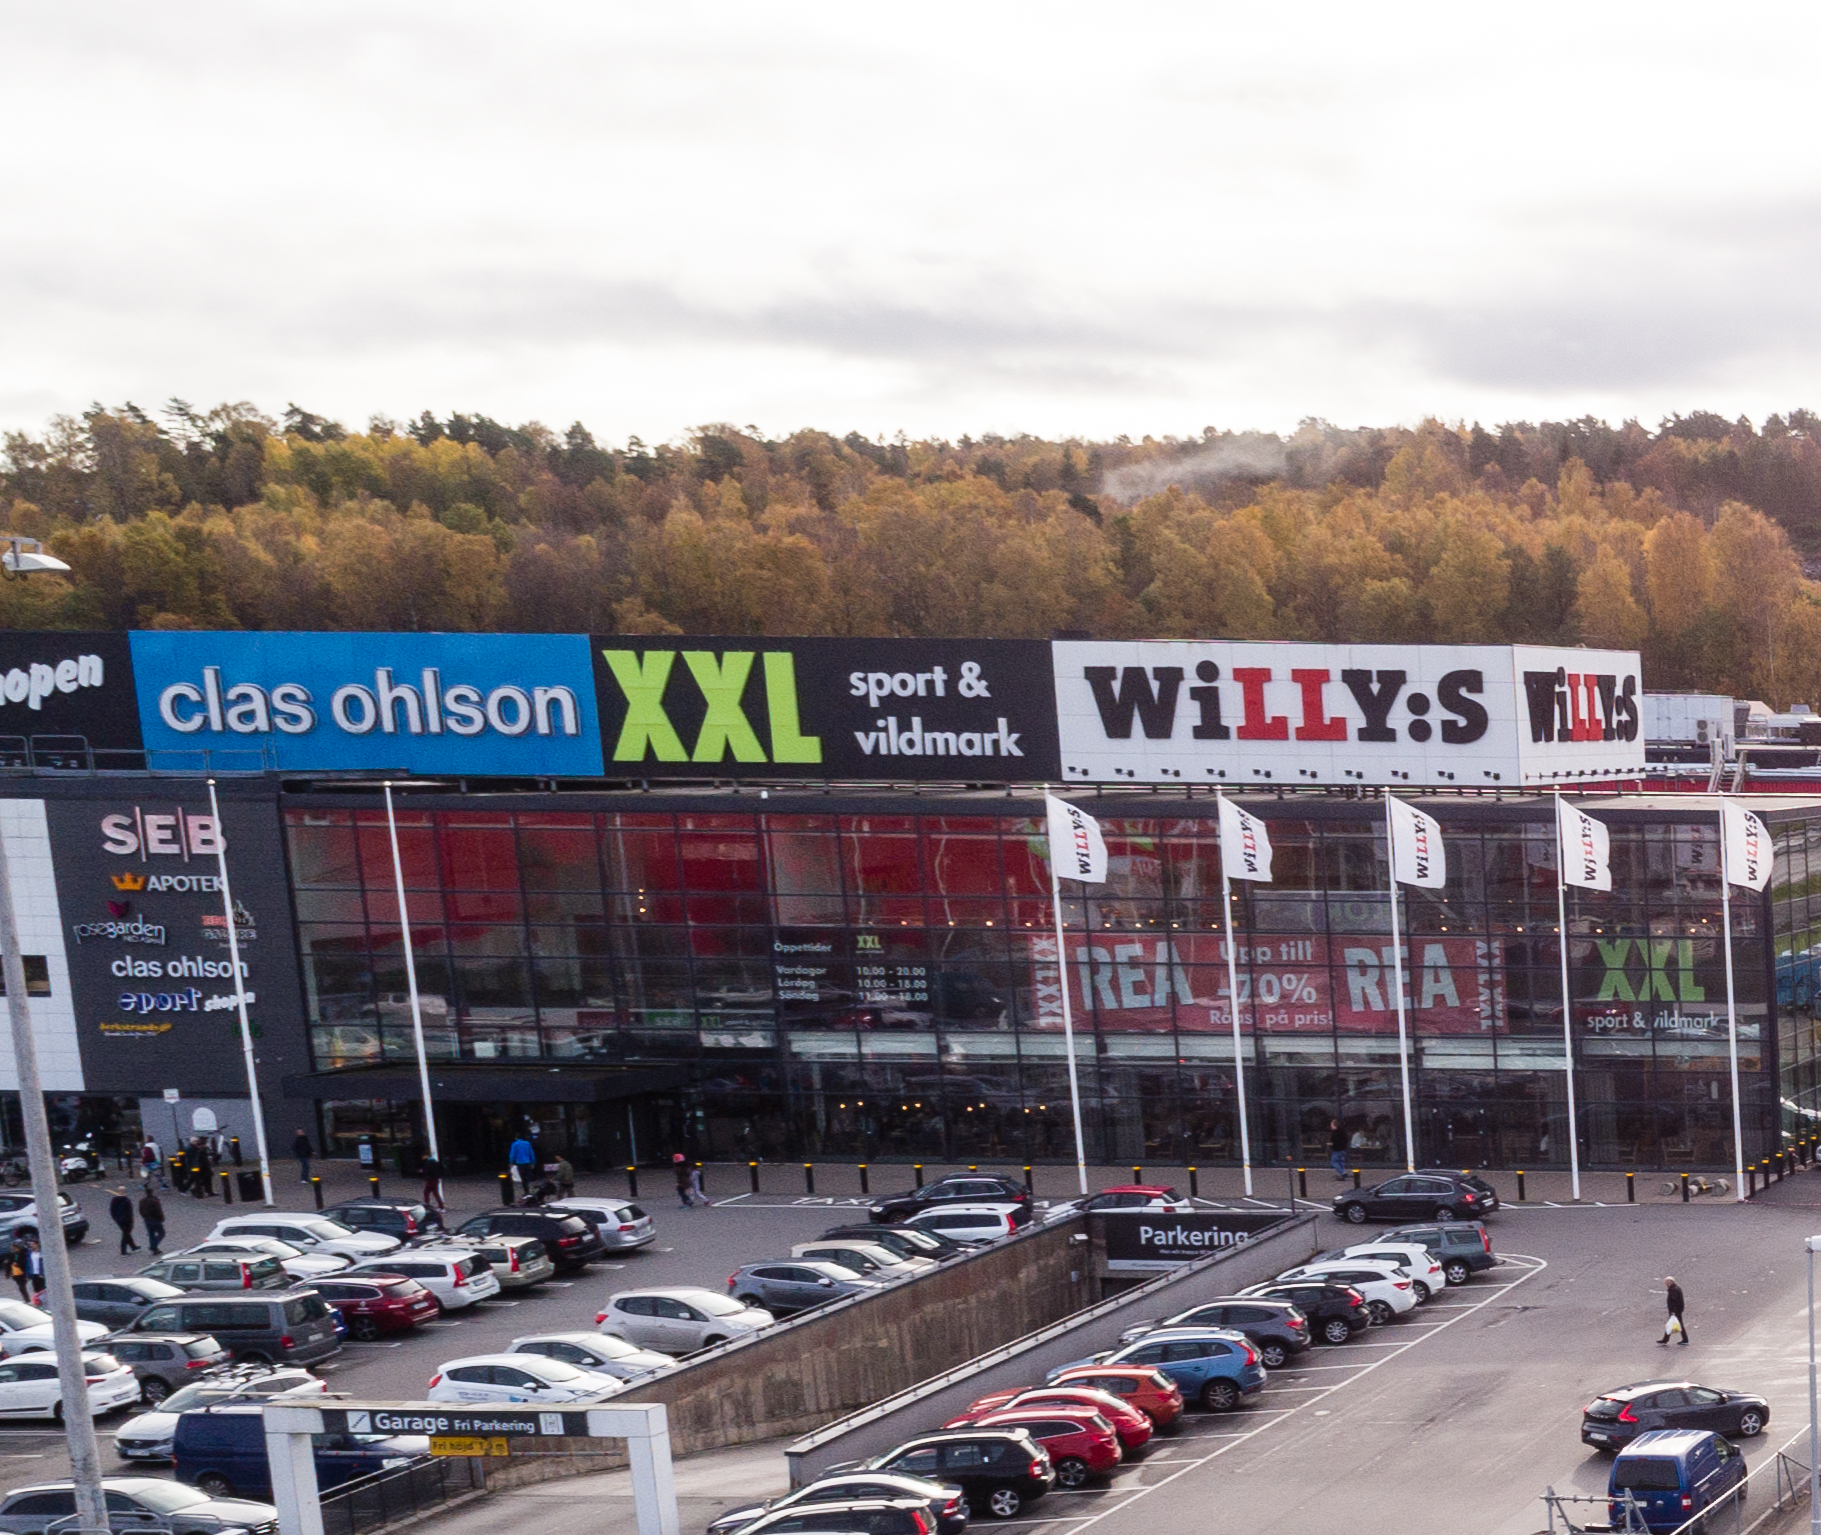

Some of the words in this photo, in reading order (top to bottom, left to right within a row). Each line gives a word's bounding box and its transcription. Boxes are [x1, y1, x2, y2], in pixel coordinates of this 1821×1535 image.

[159, 666, 317, 735] clas
[331, 667, 580, 736] ohlson
[849, 666, 948, 707] sport
[957, 661, 991, 698] &
[602, 650, 823, 763] XXL
[854, 716, 1024, 757] vildmark
[111, 955, 163, 977] clas
[167, 955, 249, 978] ohlson
[1277, 940, 1312, 961] till
[1595, 939, 1705, 1002] XXL
[1075, 941, 1195, 1012] REA
[1343, 942, 1460, 1012] REA
[1588, 1013, 1629, 1031] sport
[1632, 1013, 1646, 1029] &
[1140, 1225, 1248, 1246] Parkering
[375, 1412, 449, 1432] Garage
[454, 1419, 471, 1430] Fri
[474, 1419, 536, 1433] Parkering
